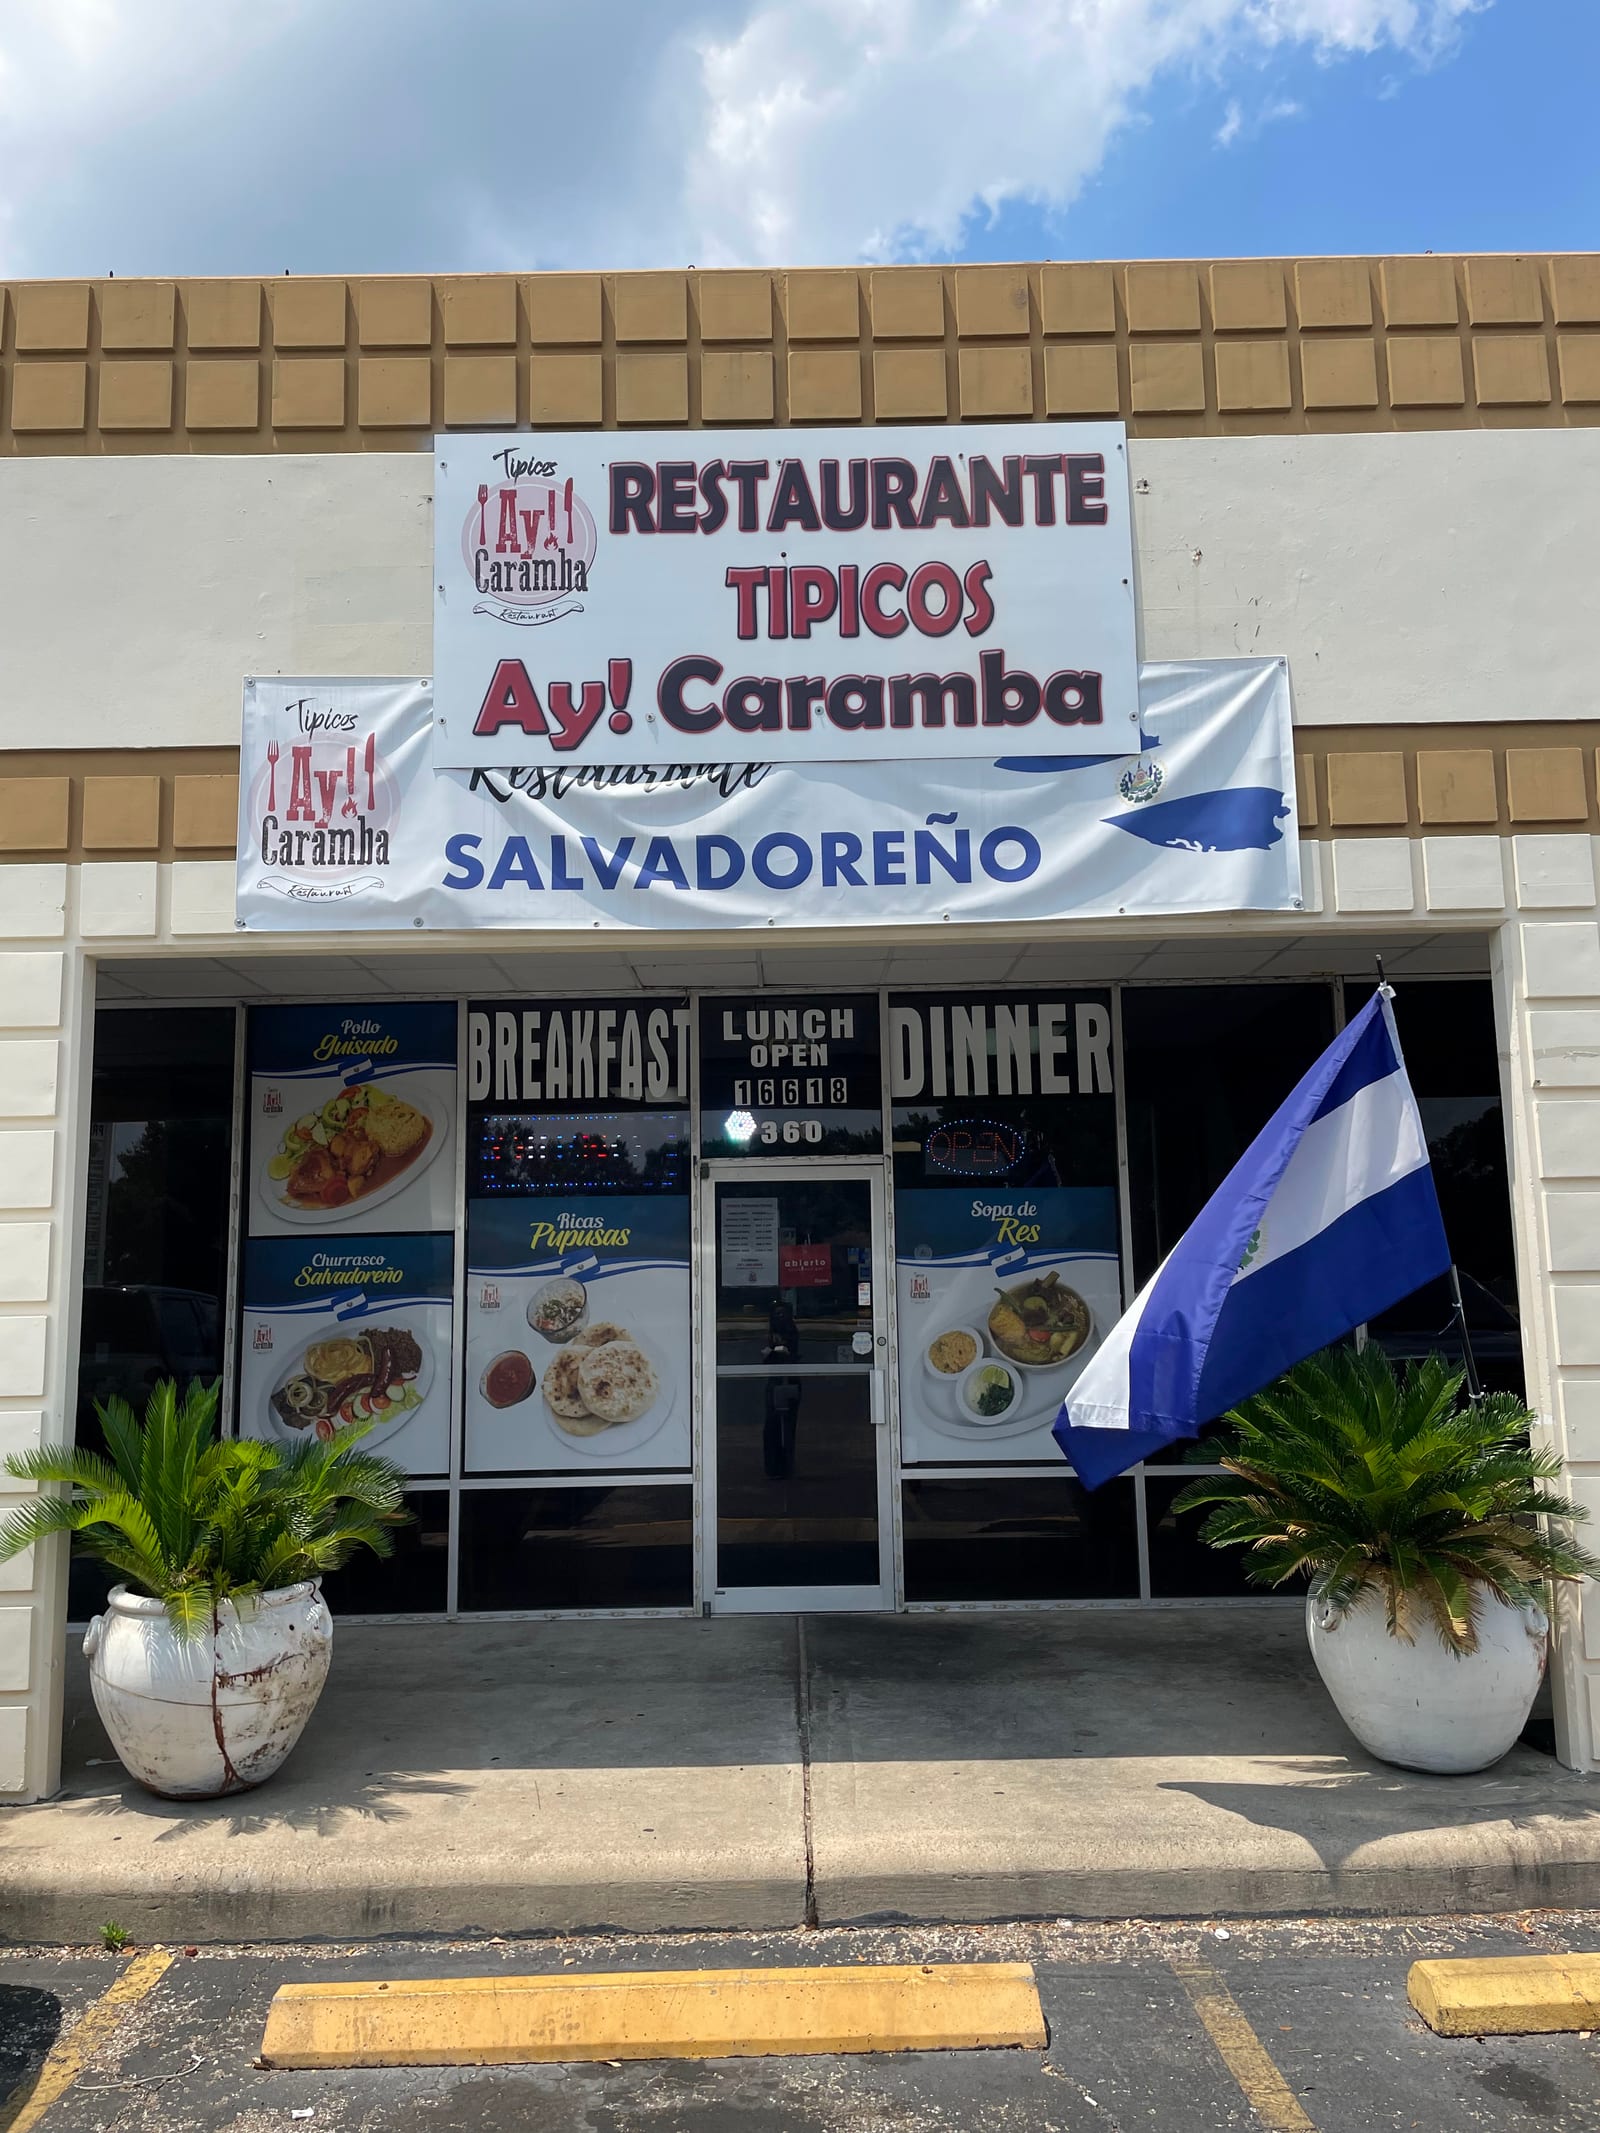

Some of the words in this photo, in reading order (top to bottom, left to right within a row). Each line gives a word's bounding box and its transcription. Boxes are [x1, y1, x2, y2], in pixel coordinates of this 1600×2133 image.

[492, 447, 558, 485] Tipicos
[609, 453, 1108, 535] RESTAURANTE
[496, 489, 558, 560] Ay!
[475, 548, 589, 593] Caramba
[500, 608, 559, 622] Restaurant
[724, 559, 995, 641] TIPICOS
[473, 657, 634, 751] Ay!
[657, 648, 1104, 734] Caramba
[285, 697, 359, 742] Tipicos
[286, 746, 359, 829] Ay!
[262, 815, 390, 866] Caramba
[442, 812, 1042, 891] SALVADOREÑO
[341, 1019, 381, 1034] Pollo
[723, 1008, 854, 1041] LUNCH
[468, 1008, 691, 1101] BREAKFAST
[750, 1044, 828, 1067] OPEN
[888, 1003, 1113, 1098] DINNER
[736, 1078, 846, 1105] 16618
[761, 1120, 822, 1144] 360
[930, 1131, 1017, 1164] OPEN
[557, 1212, 605, 1229] Ricas
[971, 1200, 1015, 1222] Sopa
[1017, 1200, 1038, 1217] de
[530, 1221, 631, 1255] Pupusas
[995, 1217, 1041, 1246] Res
[294, 1266, 404, 1287] Salvadoreño
[311, 1253, 386, 1267] Churrasco
